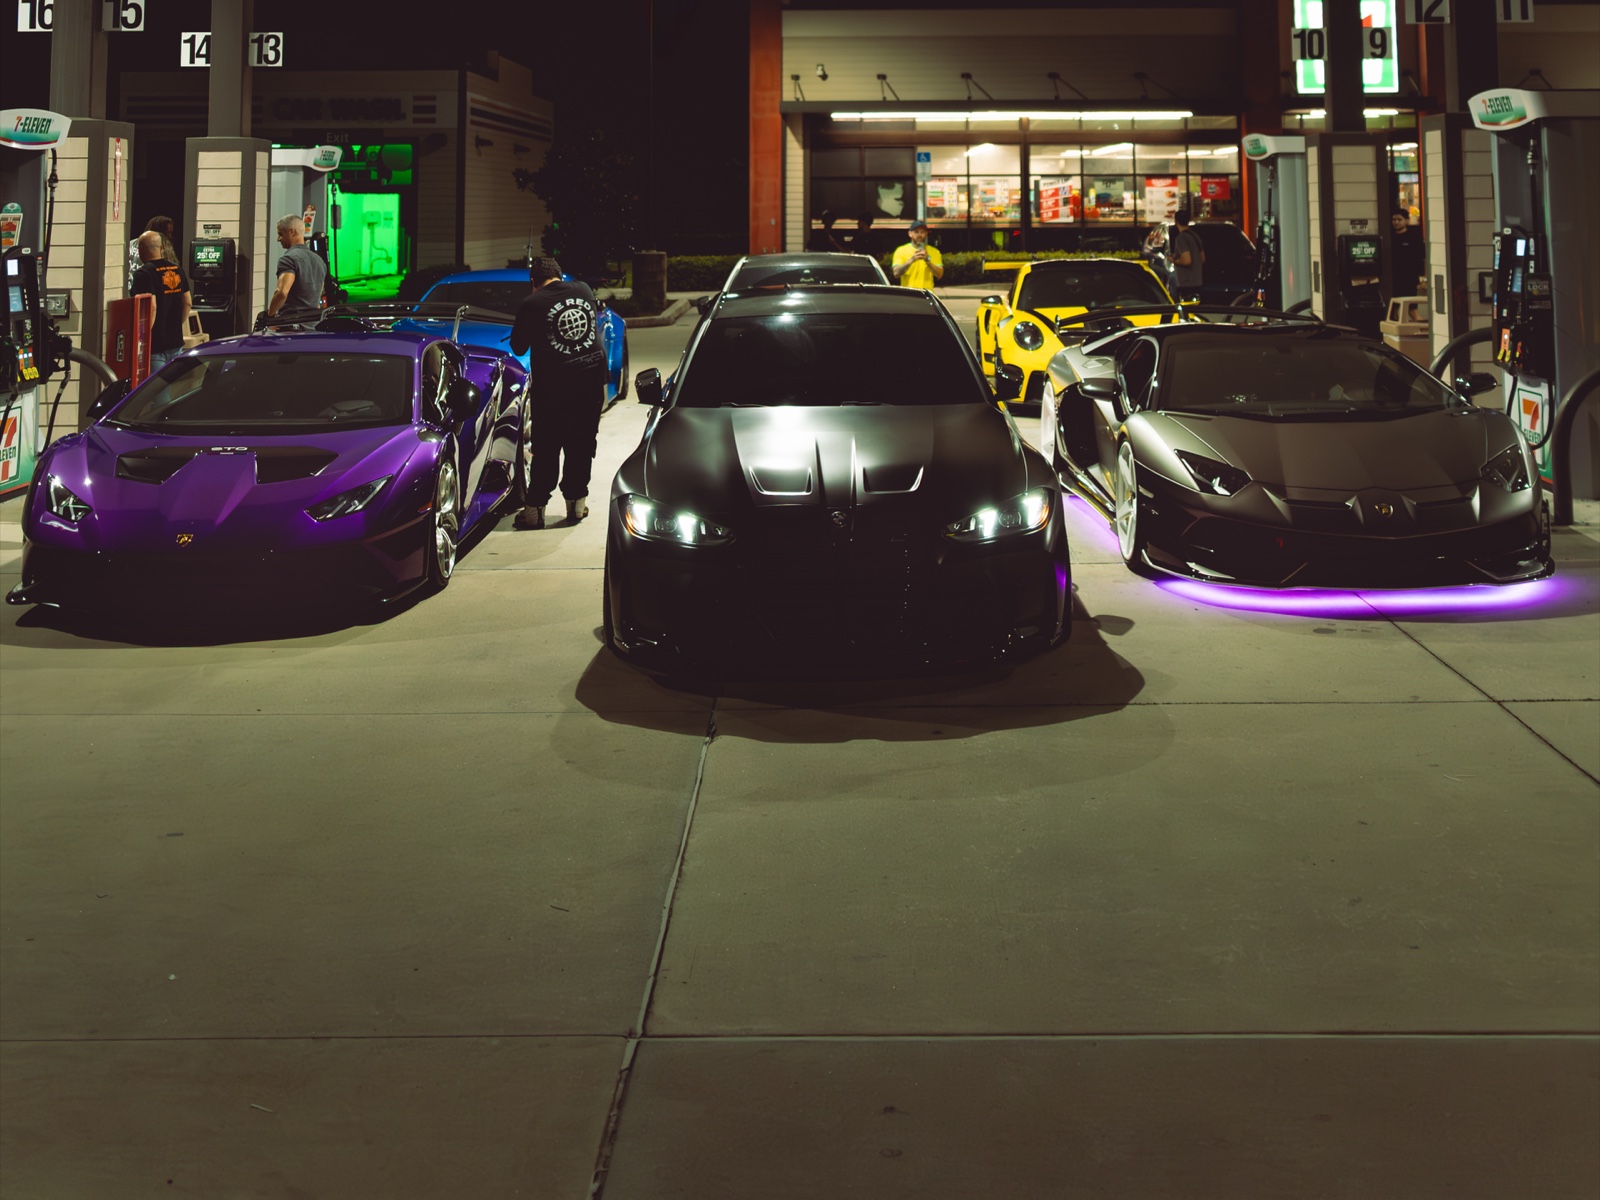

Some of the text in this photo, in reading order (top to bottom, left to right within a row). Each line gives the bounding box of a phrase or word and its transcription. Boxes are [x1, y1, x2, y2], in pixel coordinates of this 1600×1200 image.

[183, 34, 211, 65] 14
[250, 34, 281, 65] 13
[1293, 29, 1325, 60] 10
[1369, 28, 1387, 59] 9
[273, 98, 322, 121] CAR
[326, 131, 350, 143] Exit
[208, 251, 221, 259] OFF
[1363, 247, 1376, 255] OFF
